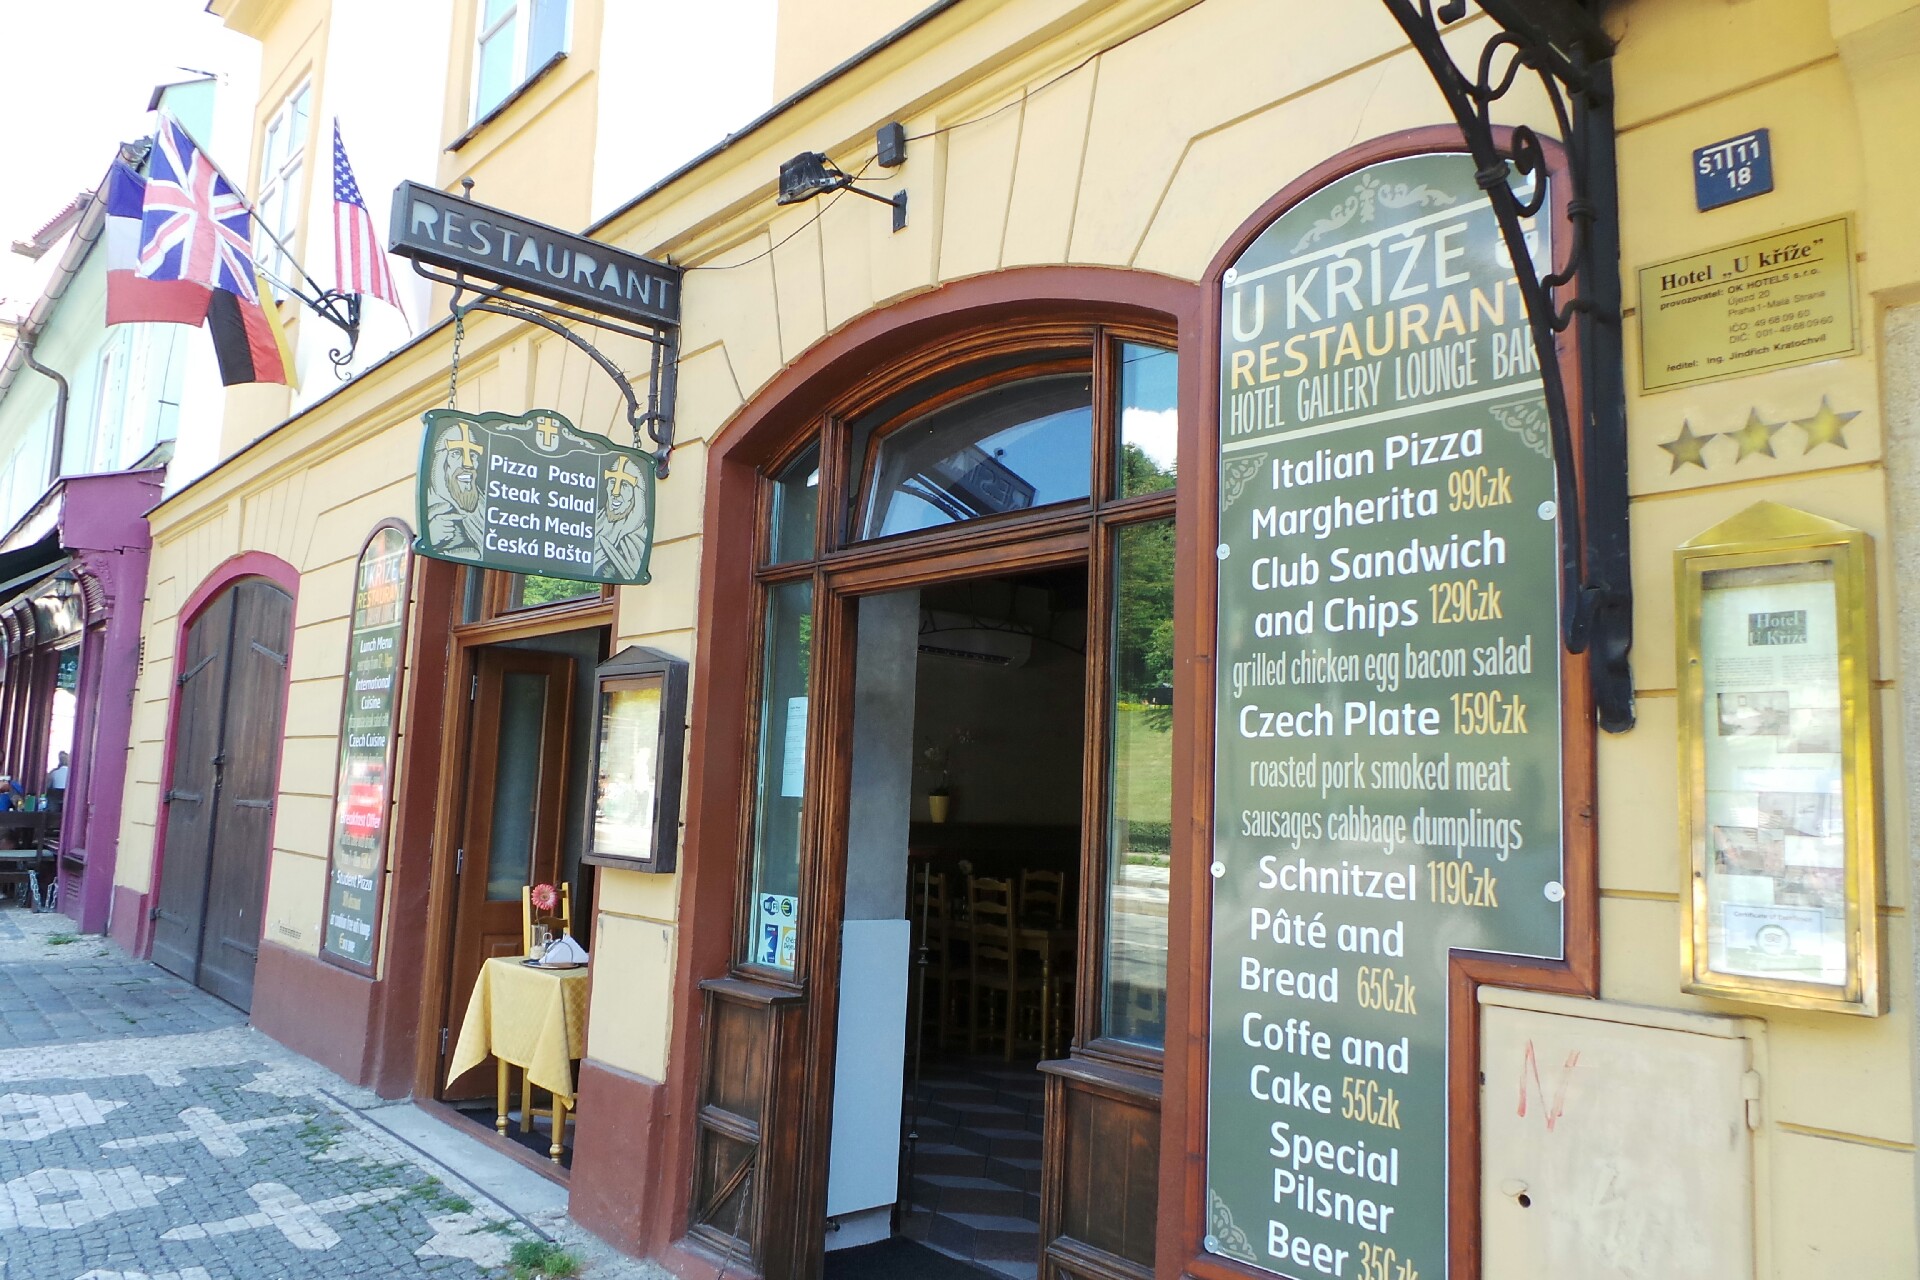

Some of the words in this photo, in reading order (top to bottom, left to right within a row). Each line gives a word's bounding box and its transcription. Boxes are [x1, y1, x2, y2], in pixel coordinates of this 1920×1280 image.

[410, 200, 673, 310] RESTAURANT
[1661, 265, 1712, 292] Hotel
[1727, 284, 1743, 294] OK
[1747, 273, 1790, 289] HOTELS
[1231, 284, 1264, 342] U
[1231, 276, 1529, 390] RESTAURANT
[1231, 385, 1285, 436] HOTEL
[1297, 362, 1382, 422] GALLERY
[1395, 338, 1479, 402] LOUNGE
[490, 454, 538, 479] Pizza
[548, 465, 596, 489] Pasta
[1271, 448, 1375, 490] Italian
[1385, 428, 1483, 471] Pizza
[487, 507, 540, 531] Czech
[545, 515, 593, 539] Meals
[488, 480, 540, 505] Steak
[547, 491, 595, 514] Salad
[1252, 487, 1439, 540] Margherita
[1448, 466, 1513, 513] 99Czk
[485, 528, 539, 556] Česká
[544, 541, 592, 564] Bašta
[1252, 552, 1319, 591] Club
[1329, 530, 1506, 583] Sandwich
[1255, 601, 1314, 638] and
[1324, 595, 1418, 637] Chips
[1428, 578, 1503, 624] 129Czk
[1757, 611, 1798, 628] Hotel
[1233, 651, 1286, 698] grilled
[1291, 649, 1360, 687] chicken
[1364, 652, 1399, 693] egg
[1405, 643, 1466, 679] bacon
[1472, 635, 1532, 676] salad
[361, 695, 381, 709] Cuisine
[1239, 703, 1333, 738] Czech
[1345, 701, 1440, 736] Plate
[1450, 690, 1529, 735] 159Czk
[349, 733, 365, 747] Czech
[366, 732, 386, 747] Cuisine
[1250, 753, 1316, 788] roasted
[1322, 753, 1365, 799] pork
[1371, 753, 1449, 790] smoked
[1456, 756, 1511, 792] meat
[1242, 809, 1322, 850] sausages
[1327, 805, 1406, 855] cabbage
[1413, 807, 1523, 862] dumplings
[1258, 855, 1416, 901] Schnitzel
[1427, 860, 1498, 908] 119Czk
[1251, 907, 1327, 949] Pâté
[1337, 920, 1404, 958] and
[1240, 957, 1339, 1003] Bread
[1356, 966, 1418, 1015] 65Czk
[1242, 1012, 1331, 1060] Coffe
[1341, 1037, 1410, 1075] and
[1250, 1064, 1332, 1114] Cake
[1341, 1076, 1402, 1130] 55Czk
[1269, 1121, 1399, 1187] Special
[1273, 1167, 1396, 1235] Pilsner
[1267, 1219, 1350, 1277] Beer
[1357, 1240, 1419, 1280] 35Czk
